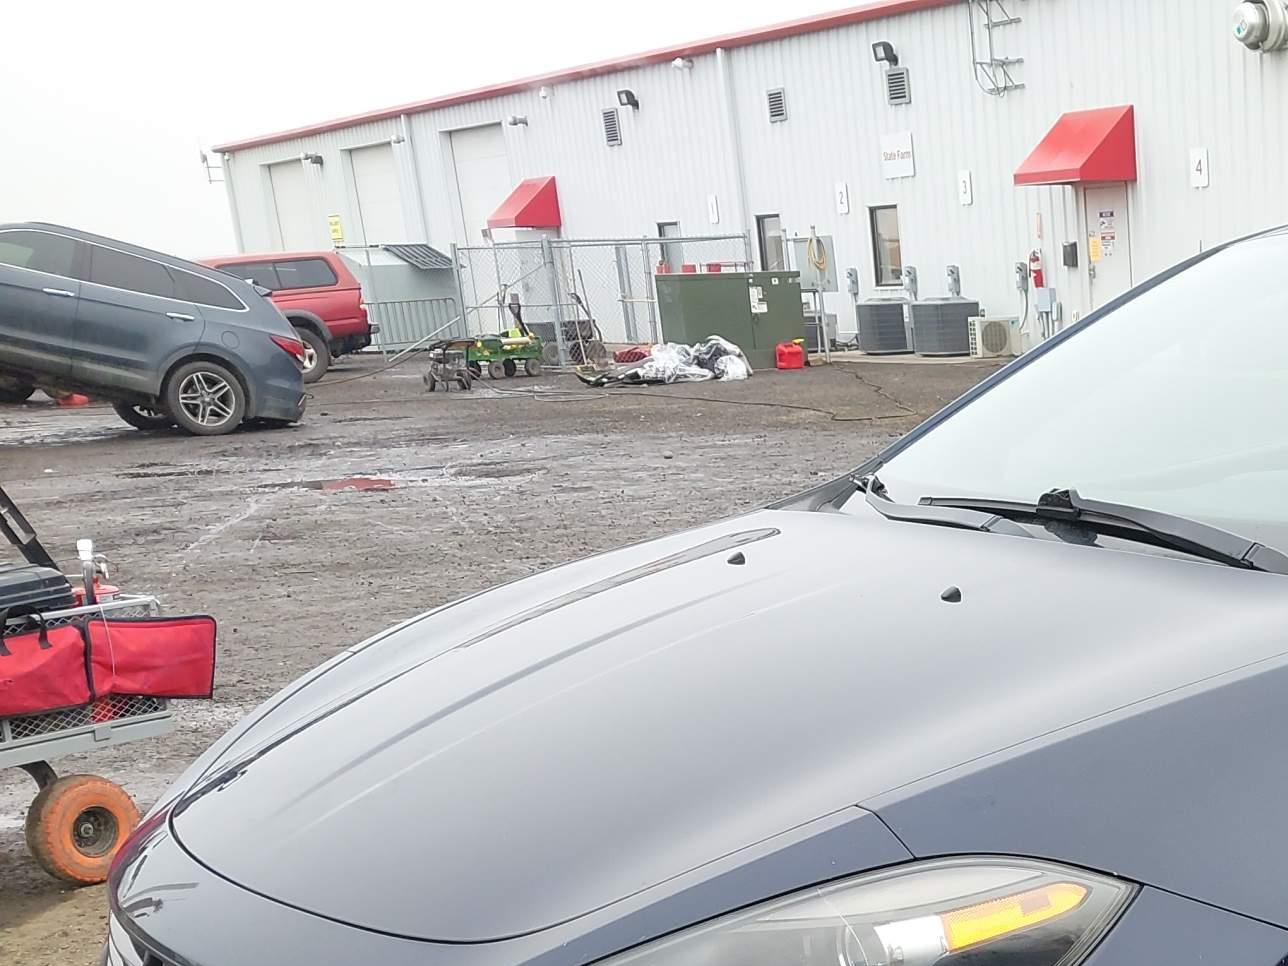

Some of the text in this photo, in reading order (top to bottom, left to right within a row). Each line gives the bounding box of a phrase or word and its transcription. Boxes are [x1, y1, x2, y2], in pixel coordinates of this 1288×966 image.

[882, 150, 911, 161] State Farm
[1195, 159, 1202, 176] 4
[838, 191, 844, 205] 2
